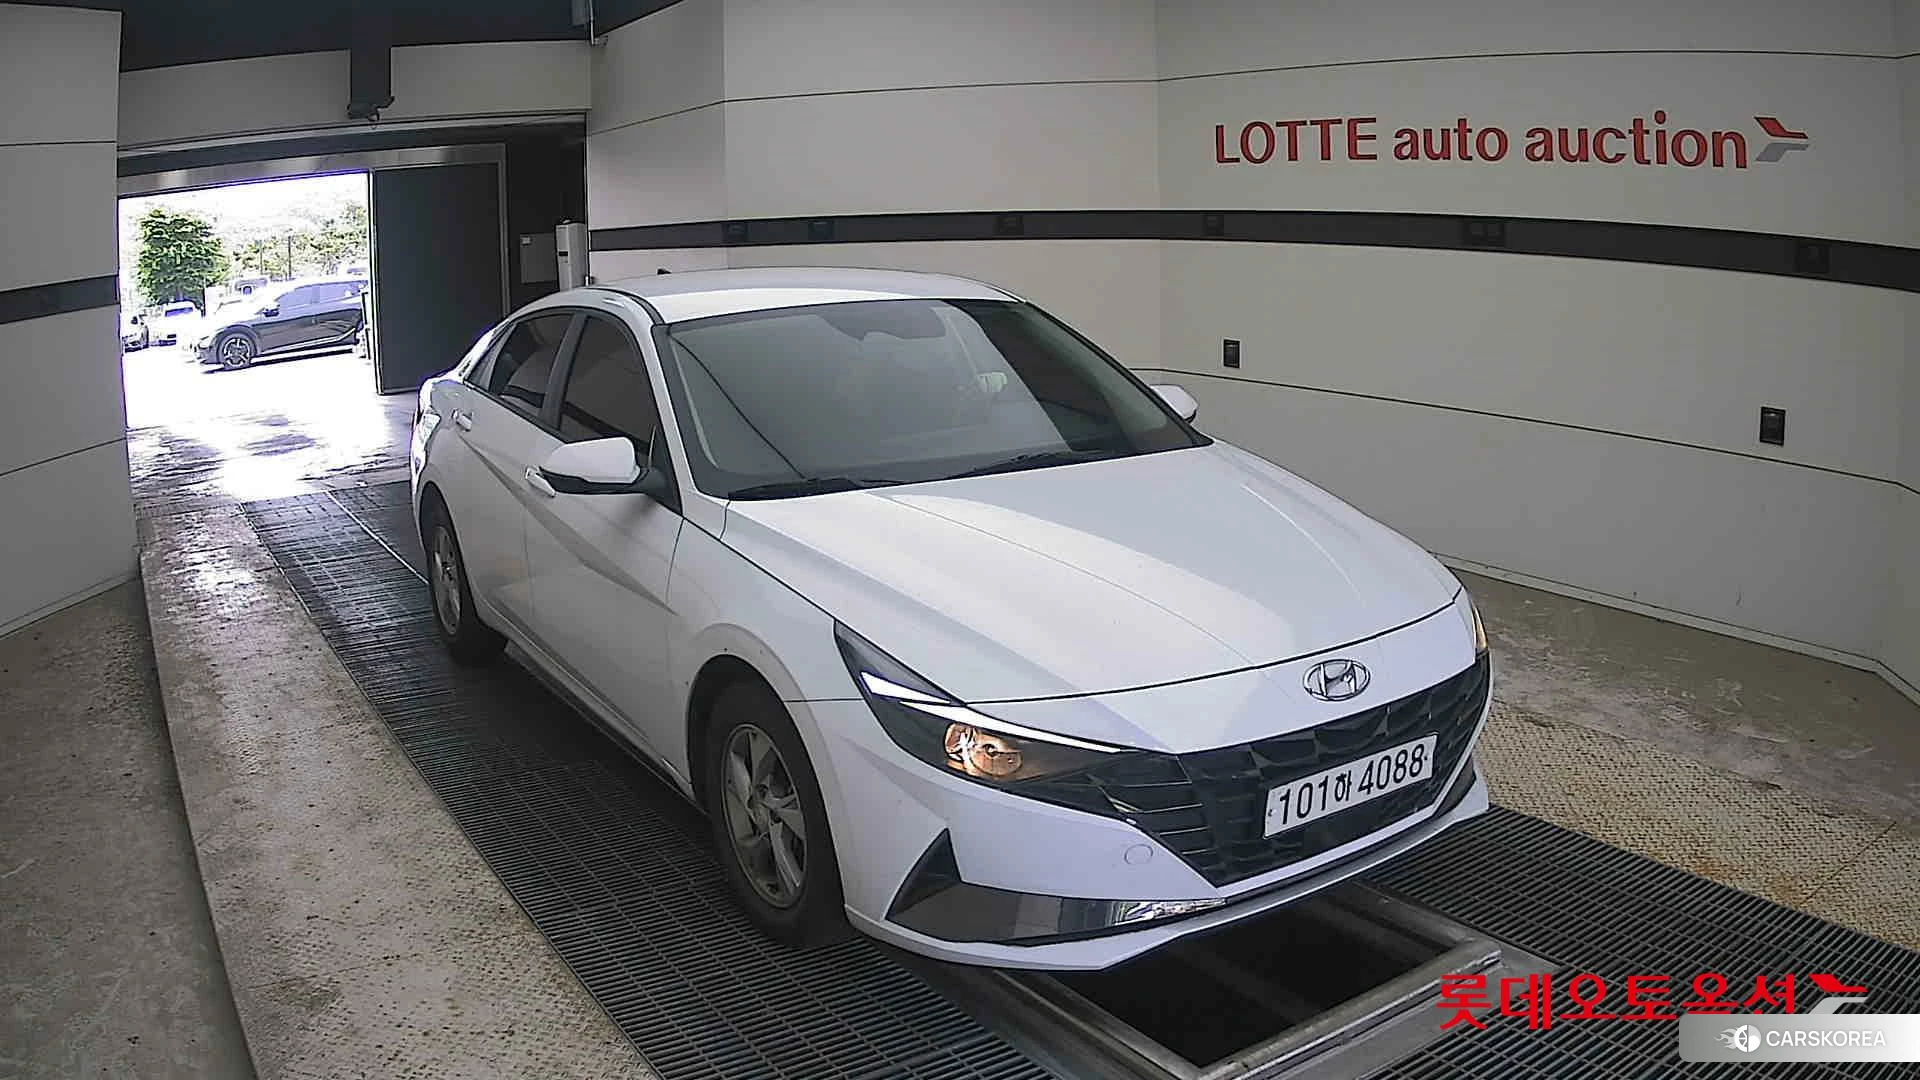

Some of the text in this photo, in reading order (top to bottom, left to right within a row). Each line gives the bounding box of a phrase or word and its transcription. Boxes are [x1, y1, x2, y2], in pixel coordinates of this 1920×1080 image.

[1215, 110, 1748, 169] LOTTE auto auction
[1279, 743, 1425, 825] 101하 4088
